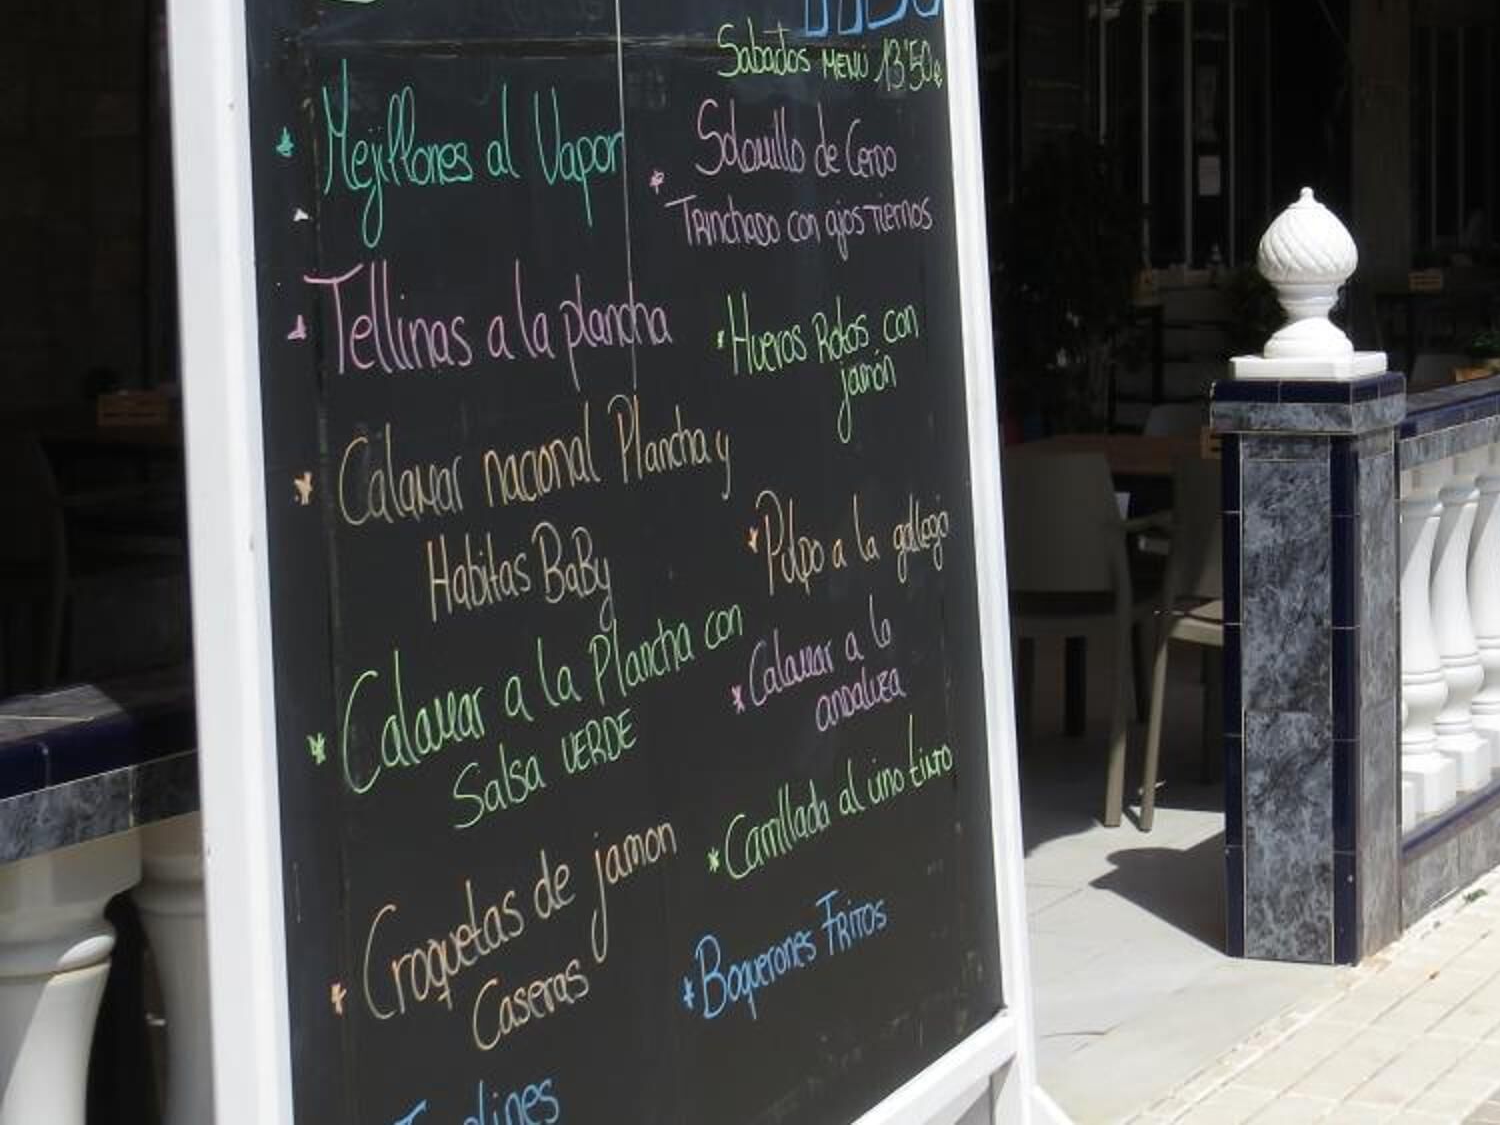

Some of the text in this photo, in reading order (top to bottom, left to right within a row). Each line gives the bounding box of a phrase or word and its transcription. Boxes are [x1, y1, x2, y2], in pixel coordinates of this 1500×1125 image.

[323, 59, 473, 248] Mejillones
[487, 84, 520, 178] al
[814, 101, 841, 177] de
[788, 209, 822, 244] con
[304, 259, 473, 375] Tellinas
[487, 315, 515, 360] a
[515, 259, 556, 360] la
[883, 304, 919, 343] con
[716, 429, 731, 500] y
[832, 538, 848, 569] a
[853, 493, 880, 562] la
[504, 675, 534, 722] a
[536, 637, 582, 707] la
[704, 604, 744, 650] con
[845, 631, 865, 662] a
[868, 593, 892, 649] la
[452, 743, 547, 829] Salsa
[839, 758, 867, 815] al
[363, 879, 525, 1020] Croquetas
[534, 849, 576, 919] de
[472, 958, 590, 1051] Caseras
[695, 930, 817, 1021] Boquerones
